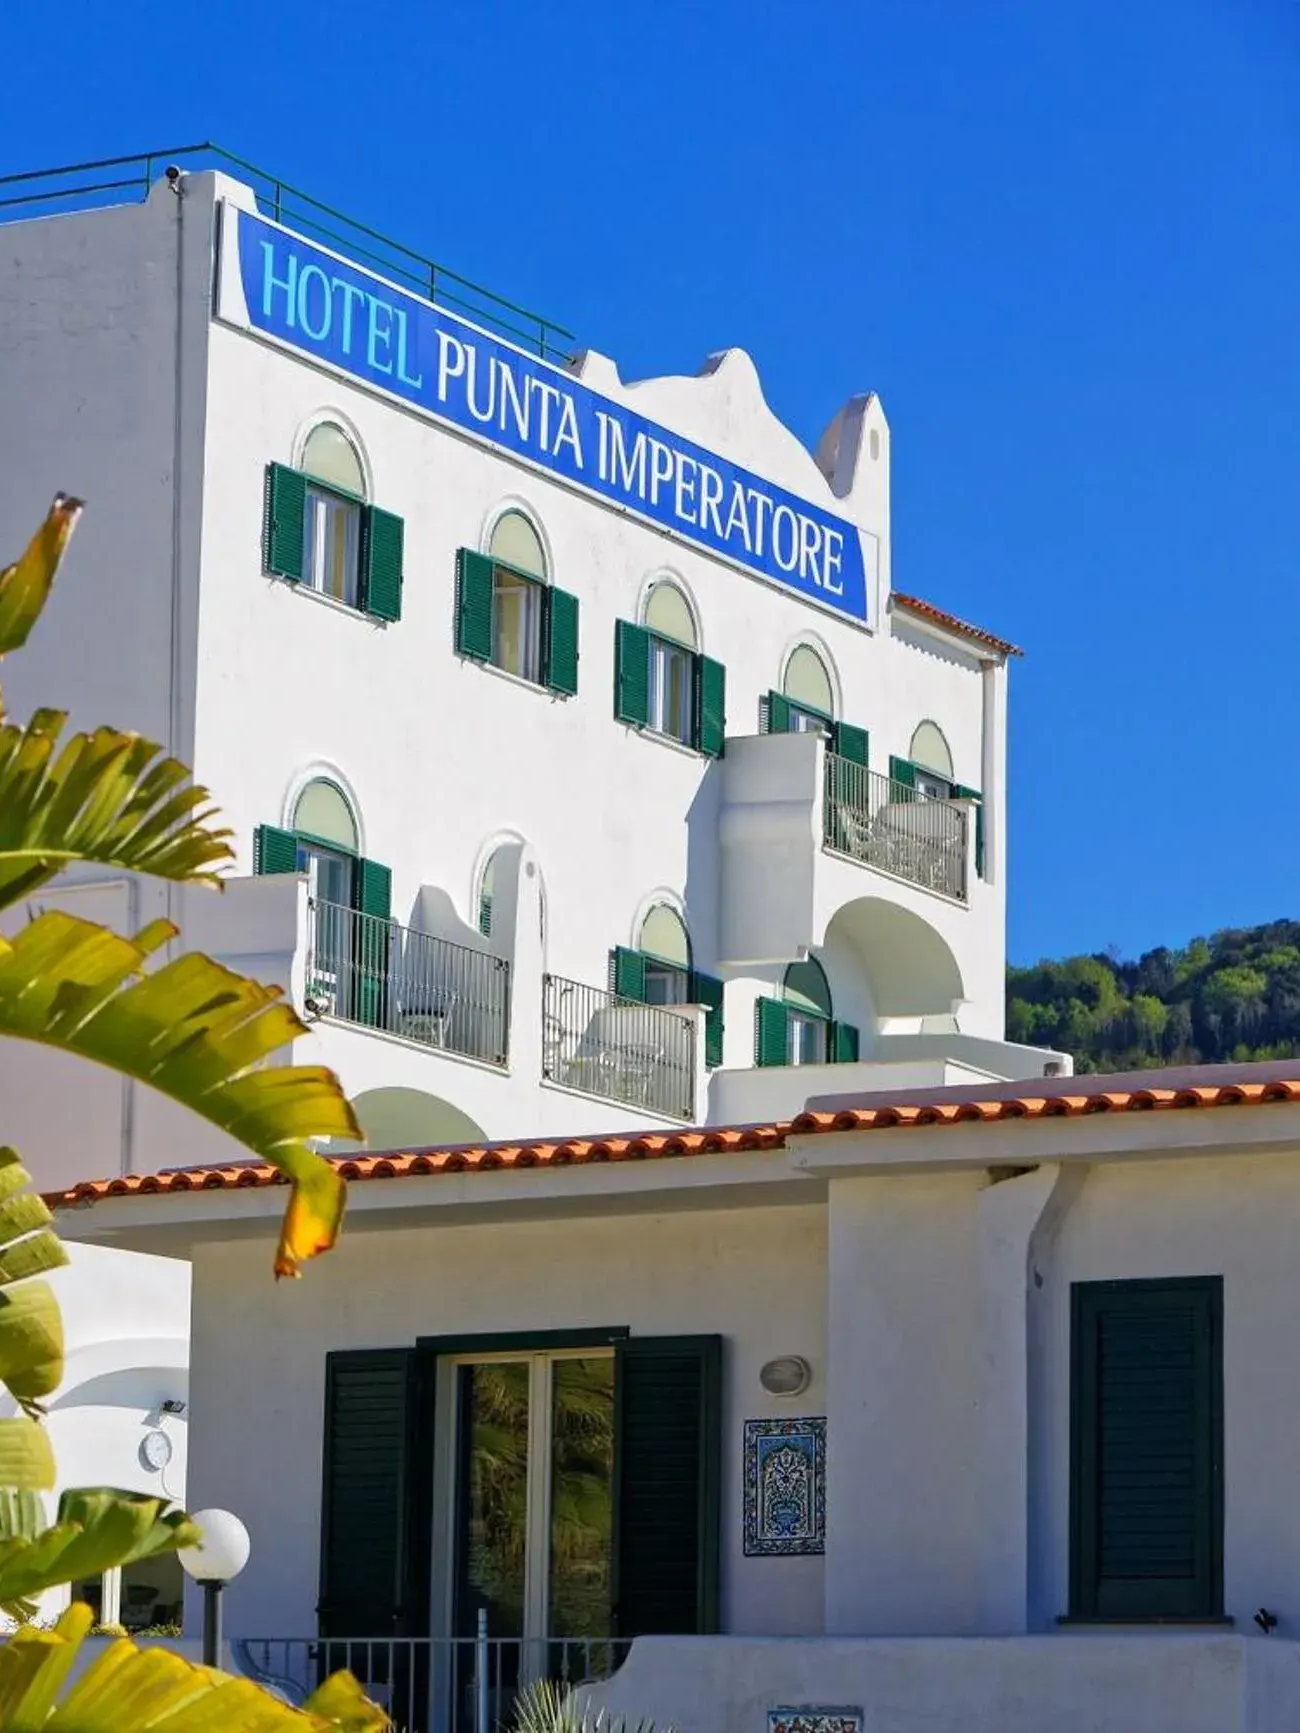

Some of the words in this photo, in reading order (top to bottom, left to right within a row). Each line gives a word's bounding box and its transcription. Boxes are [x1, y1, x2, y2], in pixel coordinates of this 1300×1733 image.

[261, 242, 422, 389] HOTEL
[436, 330, 582, 469] PUNTA
[596, 411, 844, 596] IMPERATORE
